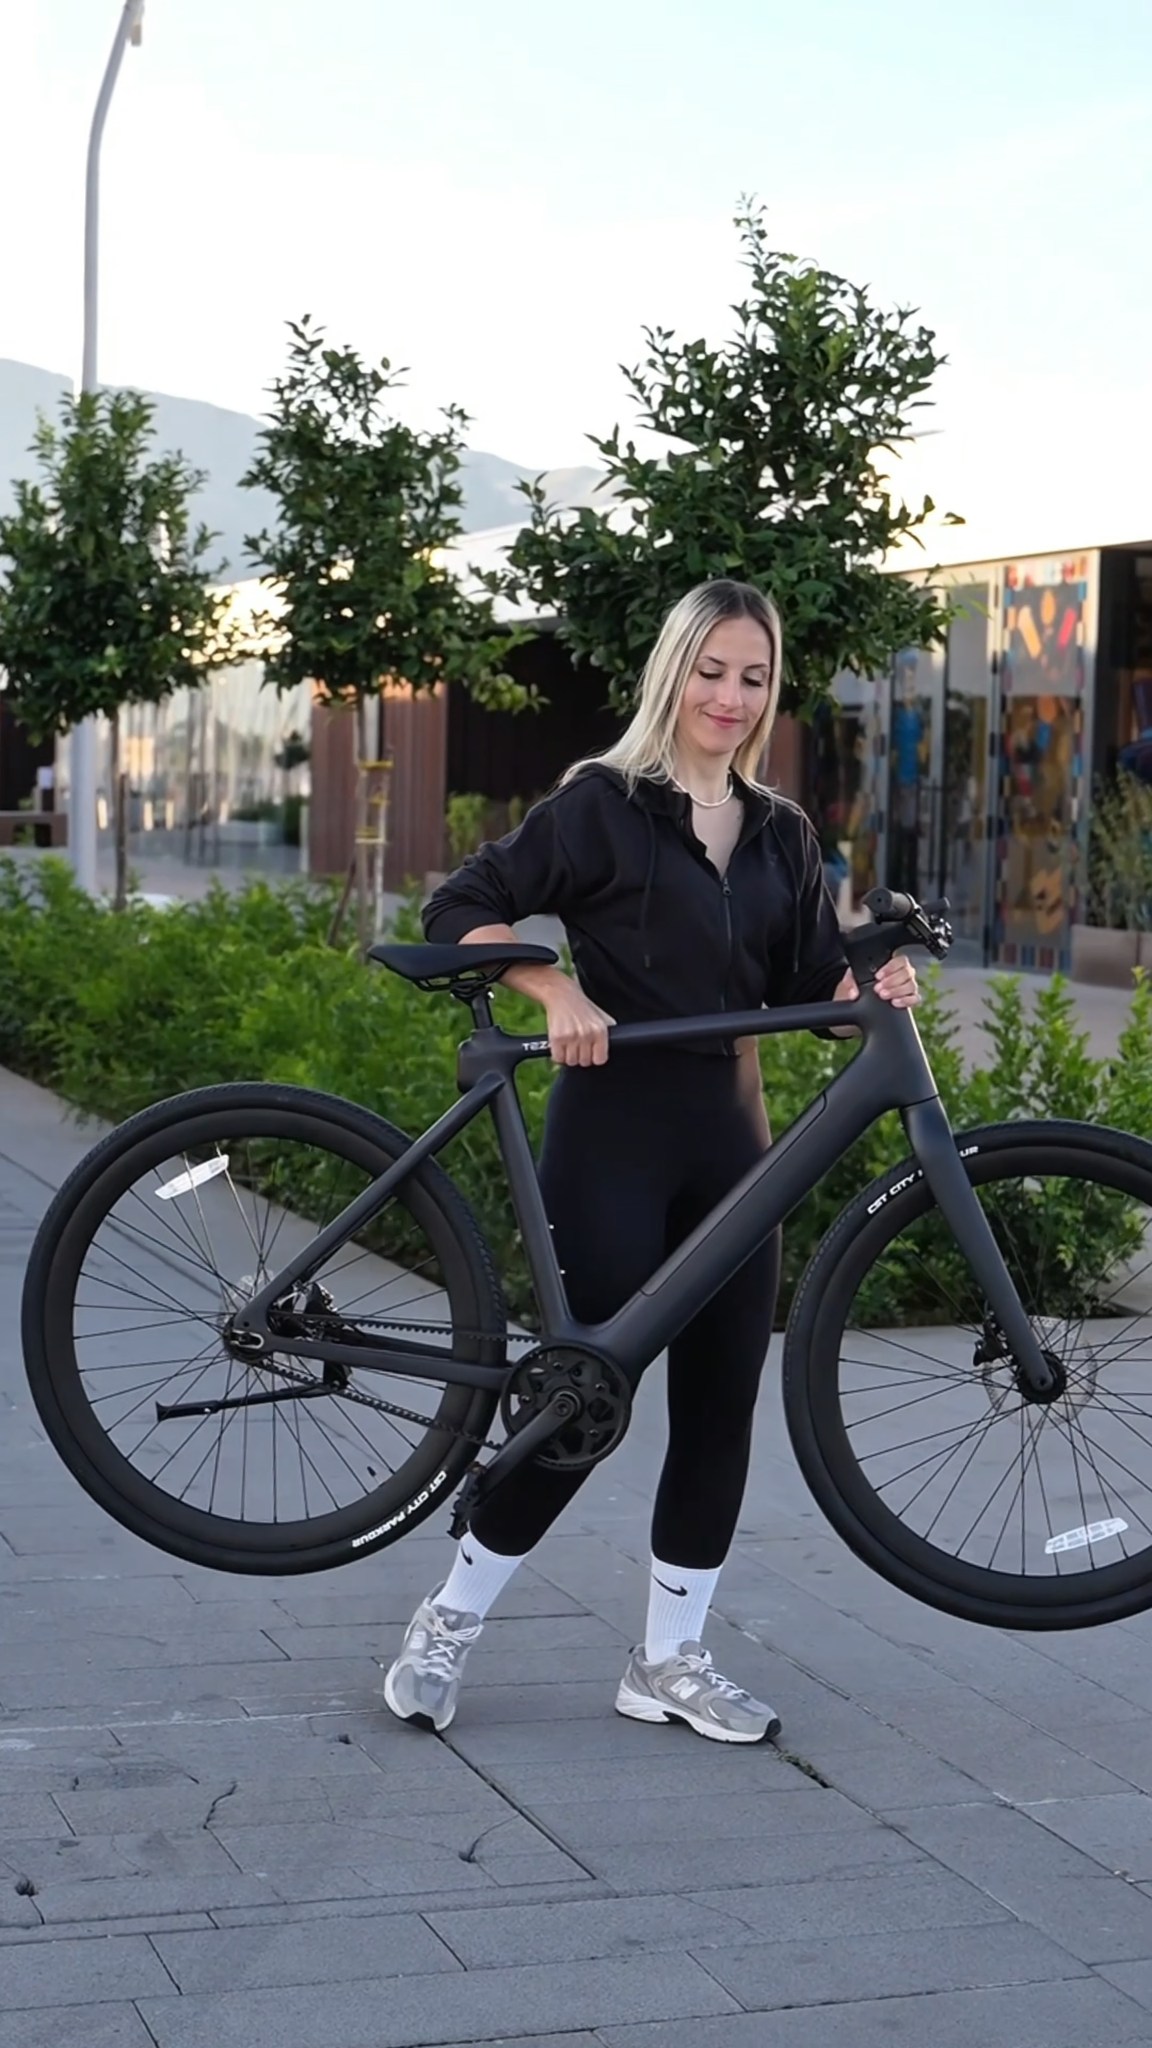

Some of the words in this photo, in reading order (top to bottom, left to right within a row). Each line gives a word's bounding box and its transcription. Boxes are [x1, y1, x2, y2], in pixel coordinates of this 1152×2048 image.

[522, 1040, 550, 1051] TEZ
[867, 1192, 888, 1214] CST
[889, 1173, 915, 1195] CITY
[429, 1470, 447, 1493] CST
[407, 1491, 429, 1515] CITY
[352, 1511, 406, 1548] PARKOUR
